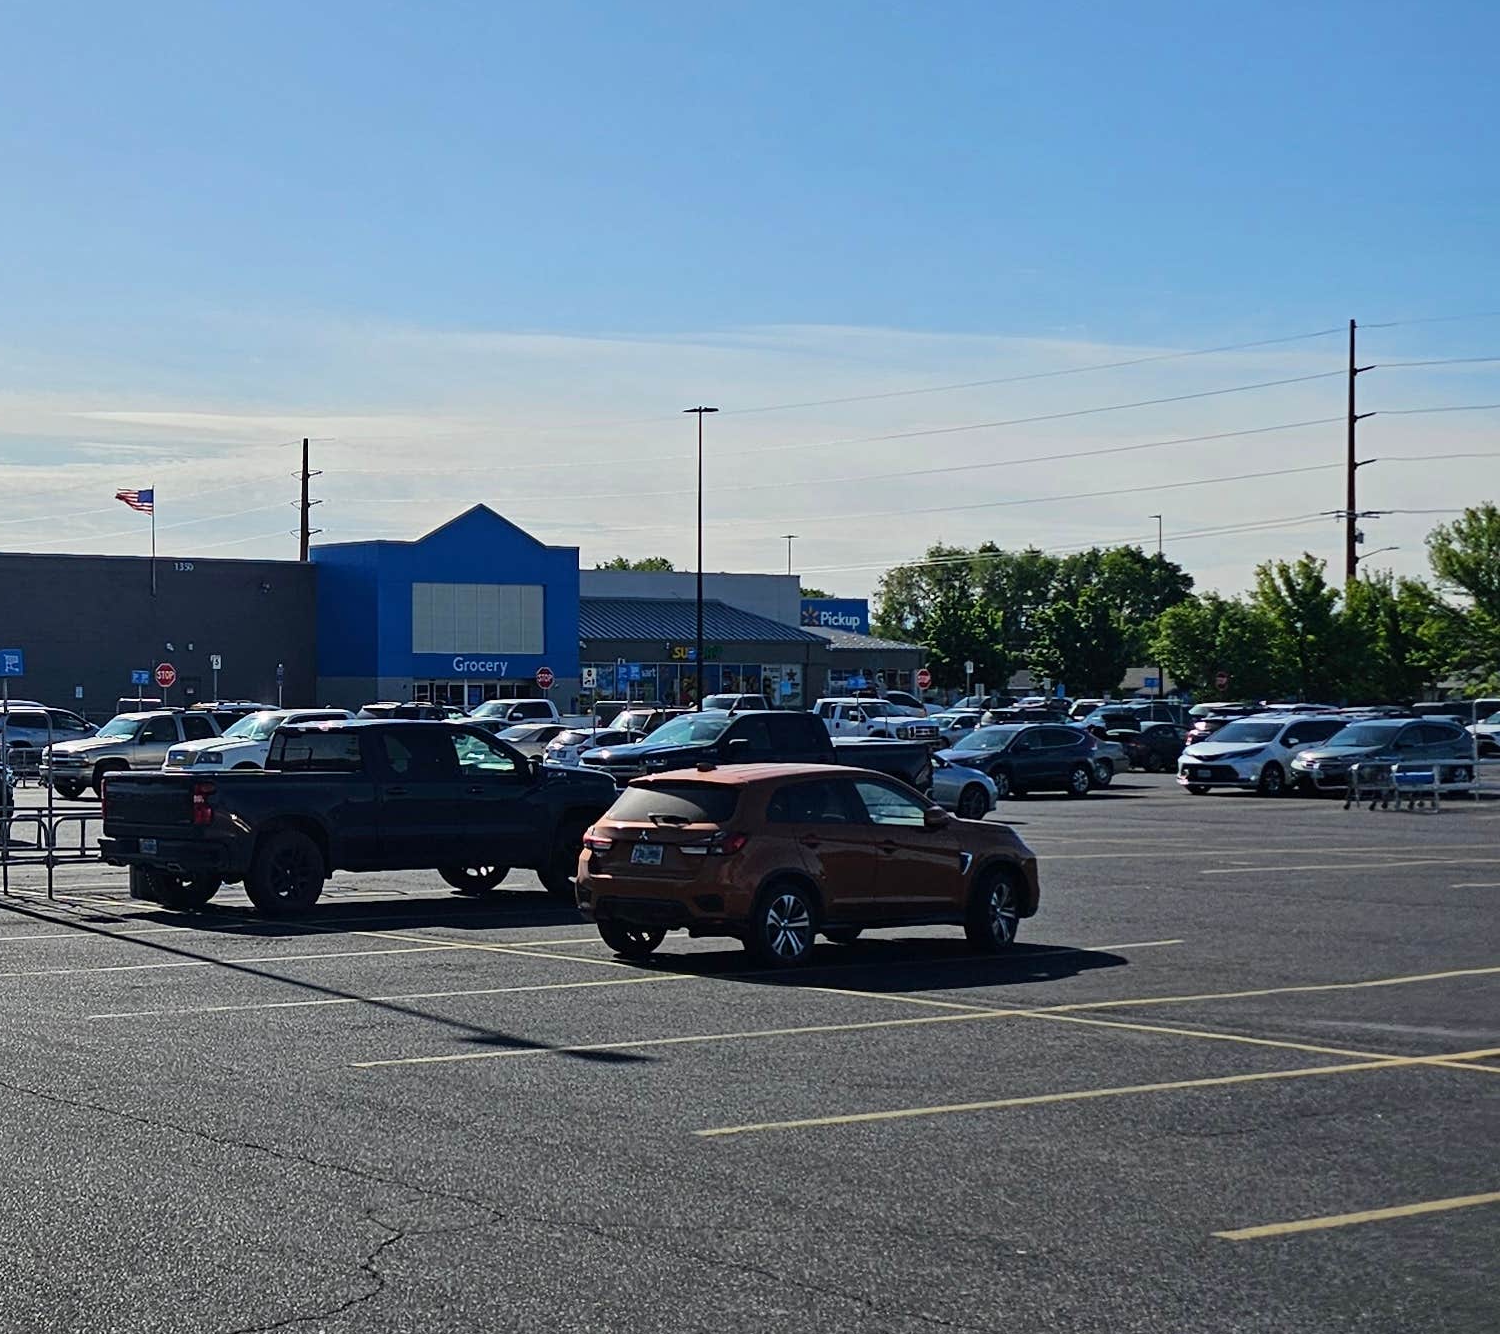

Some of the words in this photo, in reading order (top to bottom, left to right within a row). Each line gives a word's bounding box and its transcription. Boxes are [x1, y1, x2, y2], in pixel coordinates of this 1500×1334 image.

[820, 611, 860, 629] Pickup
[156, 670, 174, 680] STOP
[453, 656, 508, 676] Grocery
